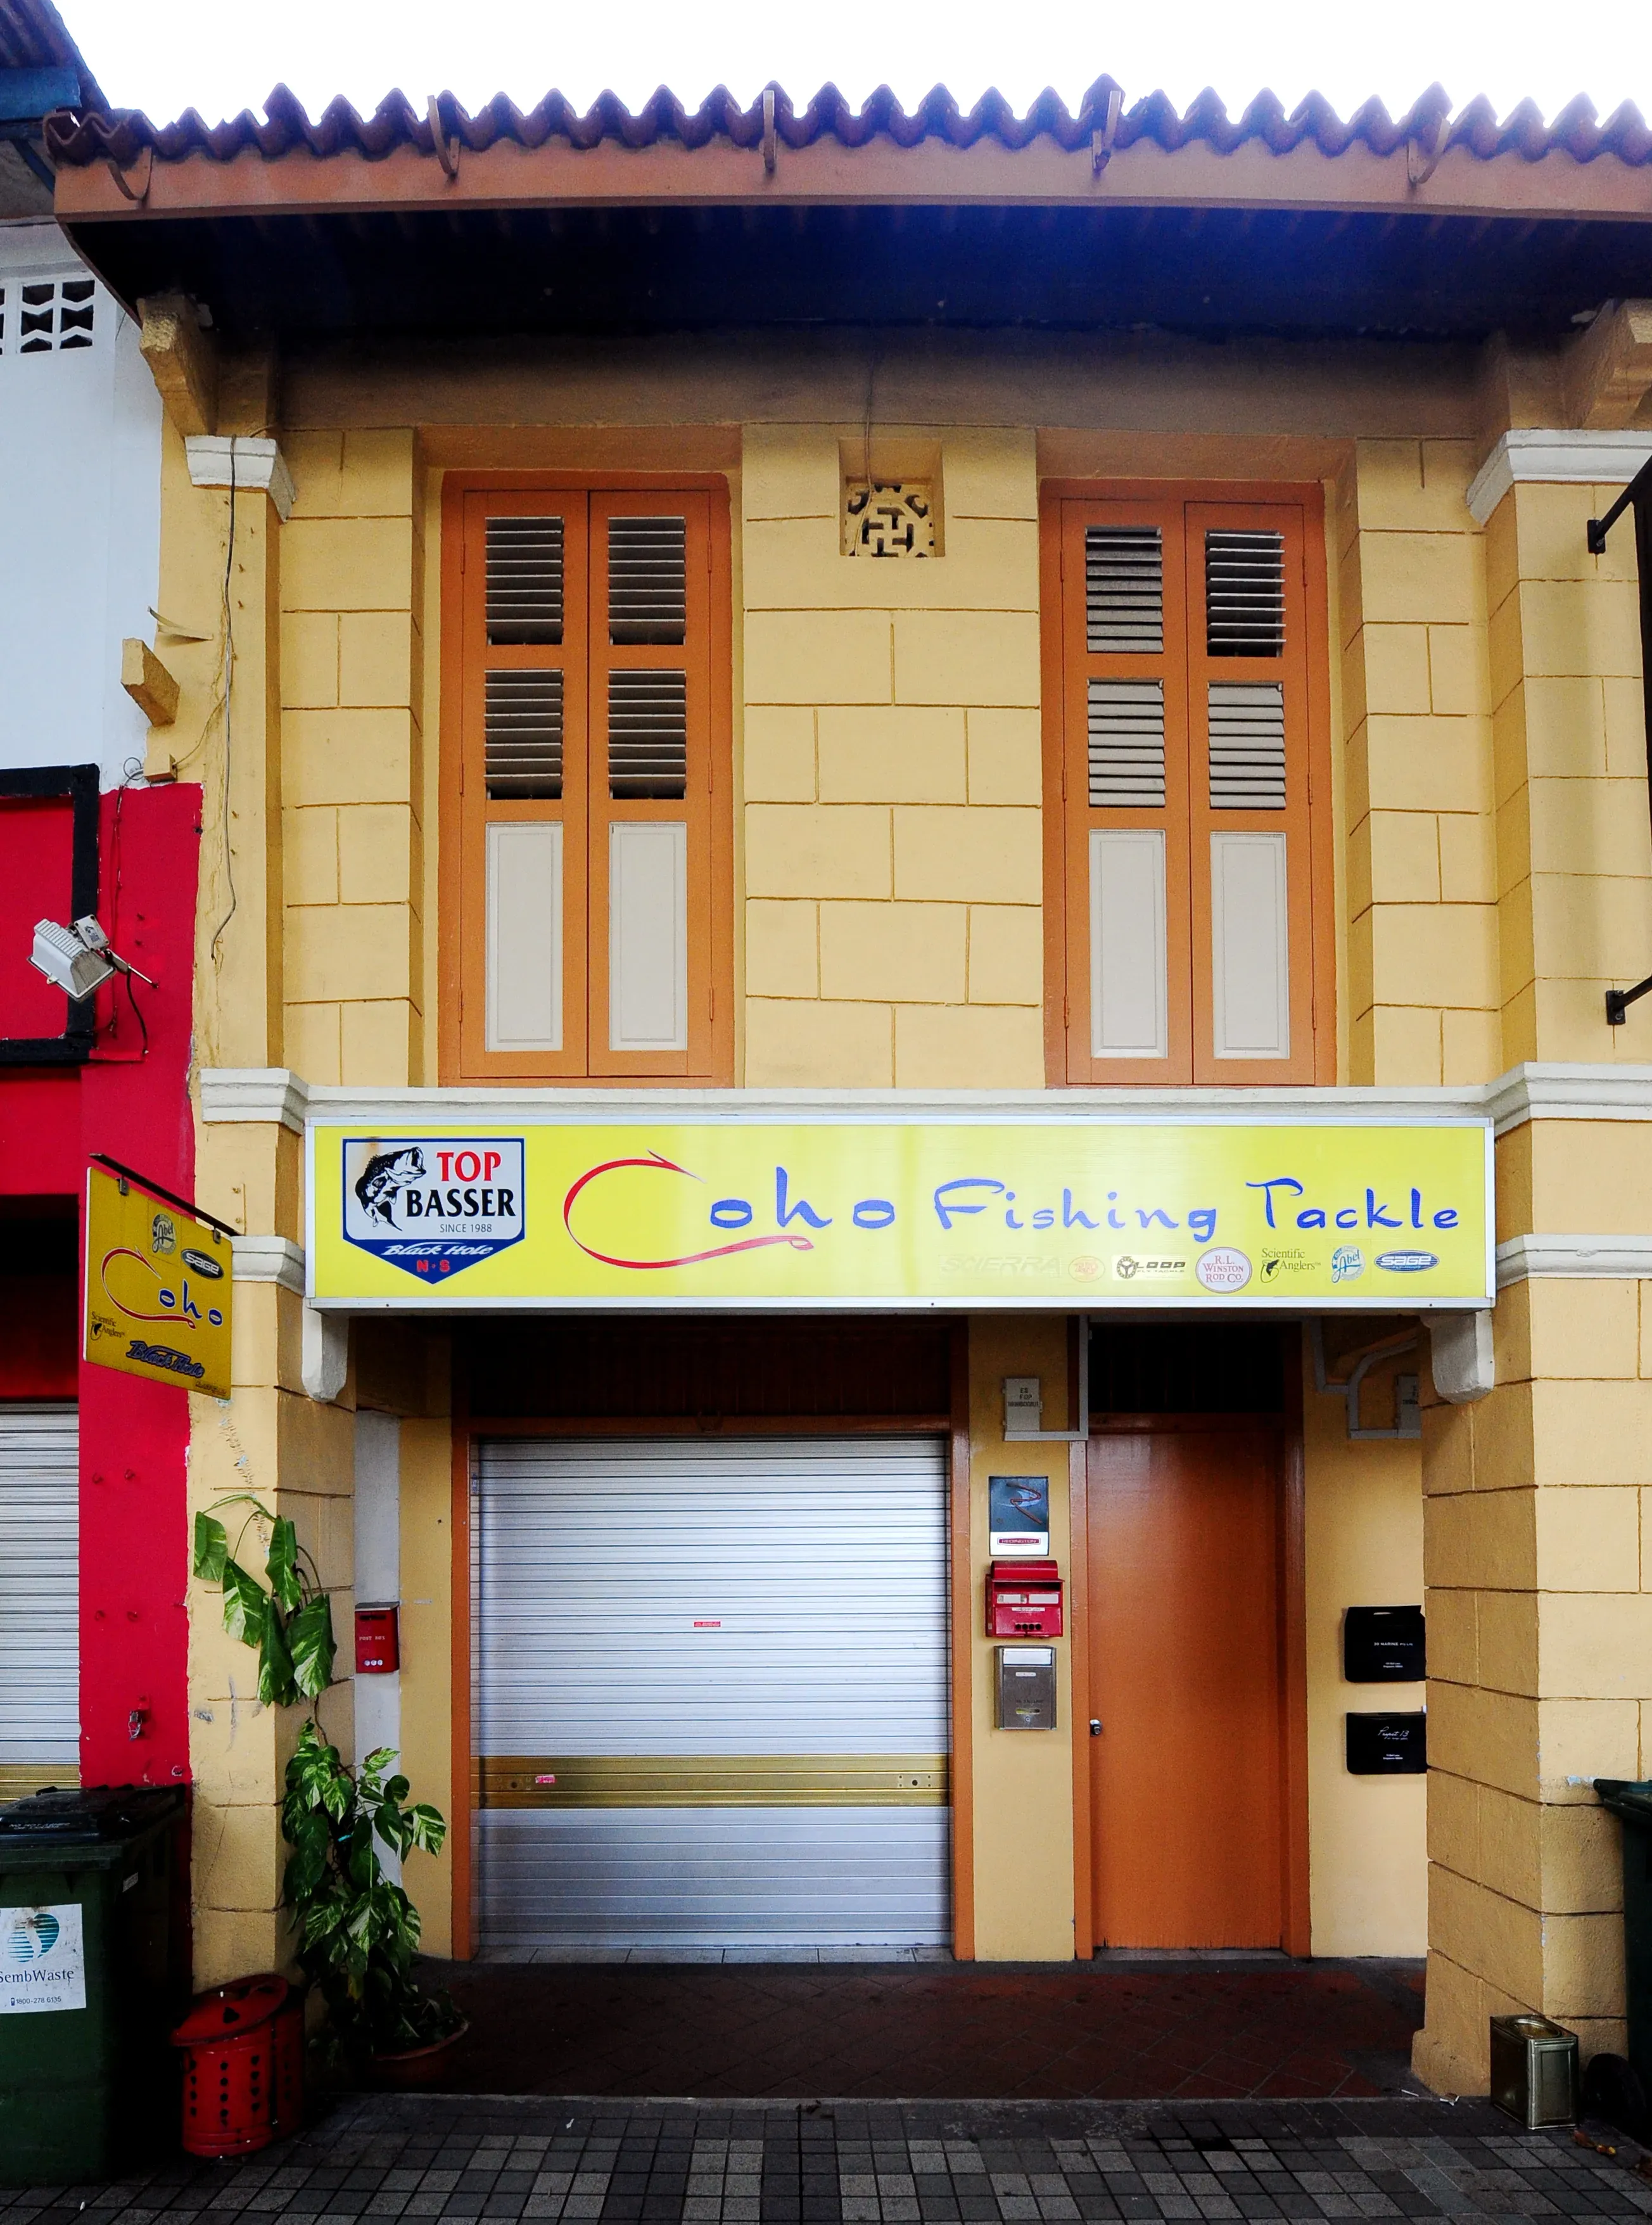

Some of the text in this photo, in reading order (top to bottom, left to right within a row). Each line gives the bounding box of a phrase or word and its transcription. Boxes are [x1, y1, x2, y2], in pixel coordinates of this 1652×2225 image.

[437, 1151, 501, 1182] TOP
[406, 1189, 516, 1217] BASSER
[934, 1177, 1217, 1243] Fishing
[1245, 1177, 1459, 1230] Tackle
[440, 1223, 492, 1233] SINCE 1988
[380, 1242, 493, 1256] Black Hole
[1261, 1247, 1306, 1258] Scientific
[1202, 1263, 1243, 1273] WINSTON
[1205, 1273, 1225, 1283] ROD
[91, 1311, 117, 1327] Scientific
[0, 1968, 74, 1984] SembWaste
